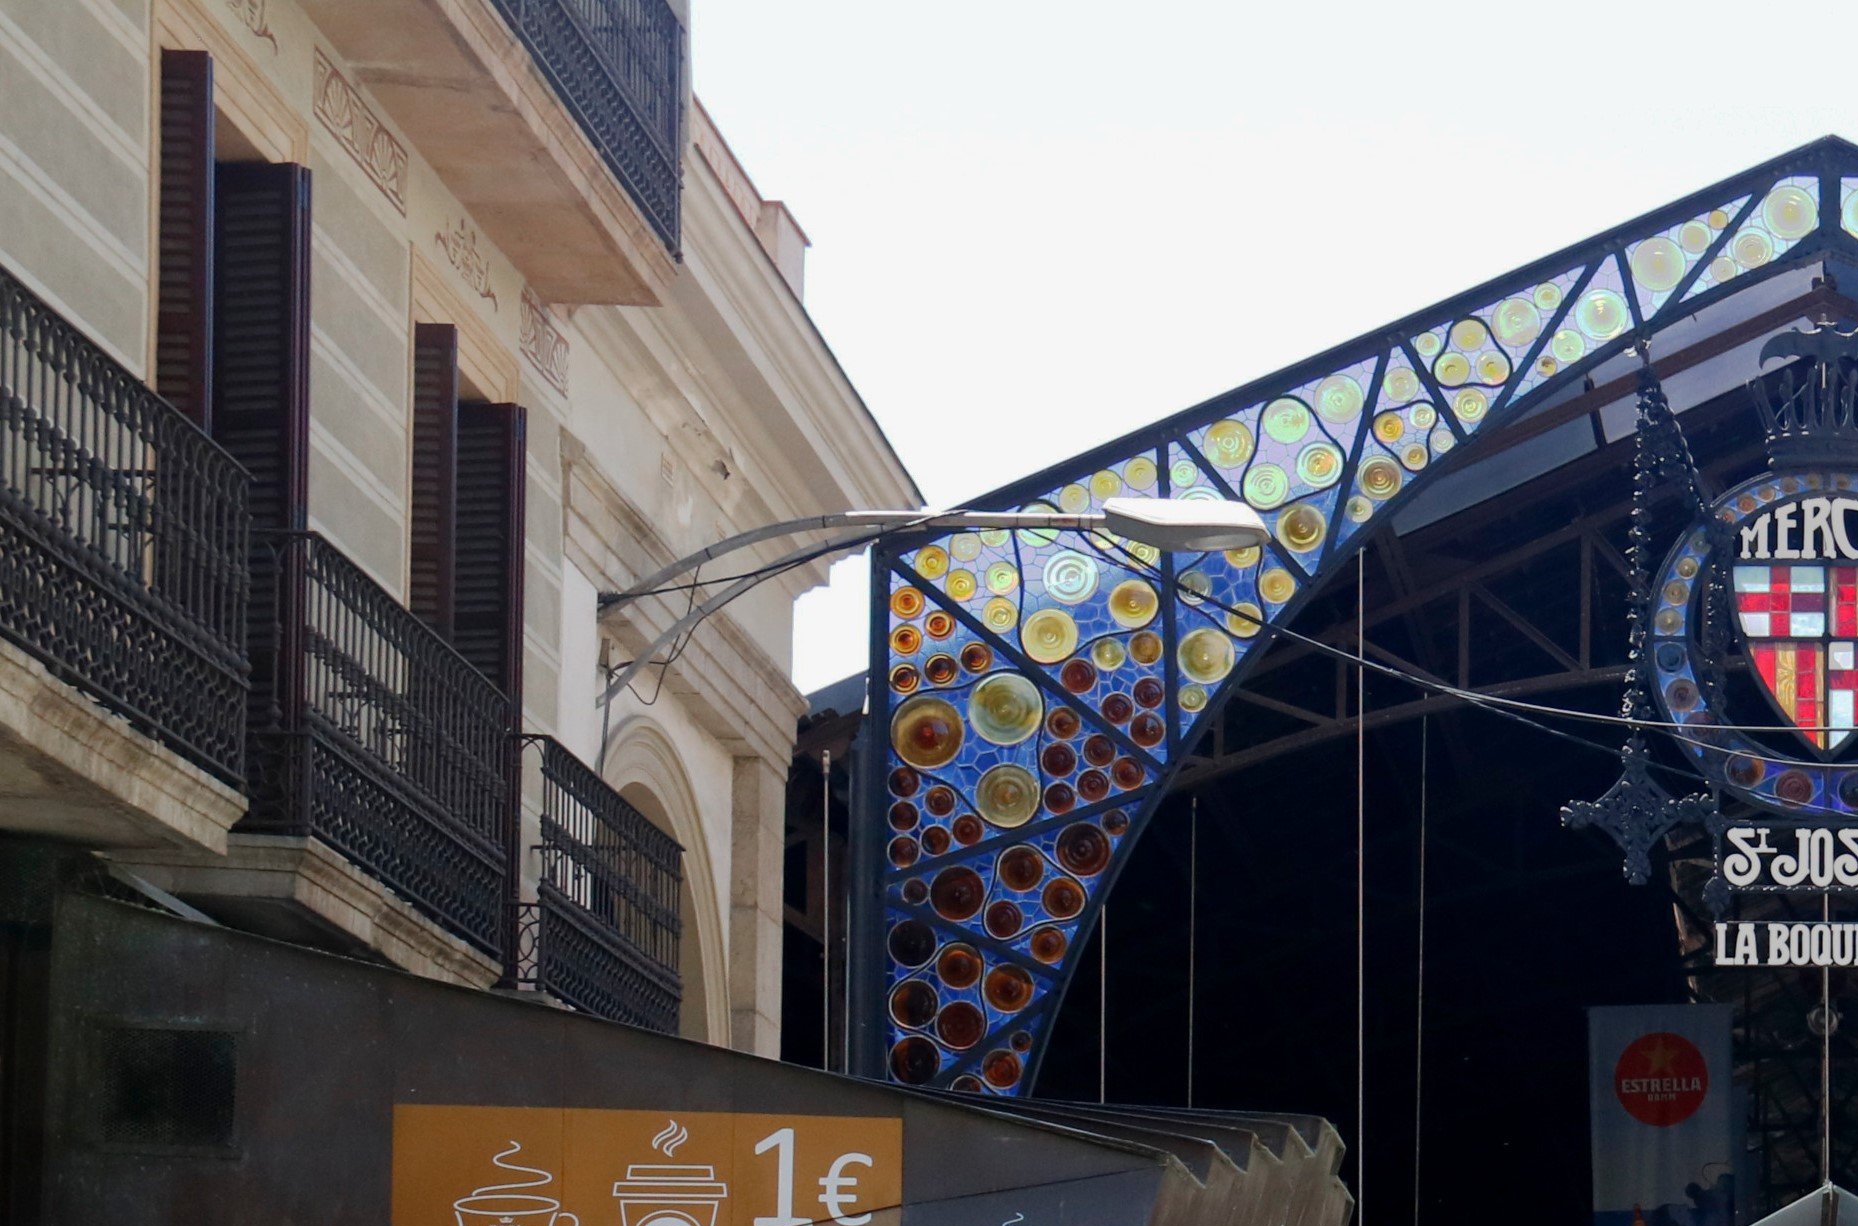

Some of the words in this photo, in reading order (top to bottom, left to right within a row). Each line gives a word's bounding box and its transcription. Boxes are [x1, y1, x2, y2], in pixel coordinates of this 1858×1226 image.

[1715, 922, 1759, 966] LA
[1621, 1077, 1702, 1093] ESTRELLA
[1647, 1092, 1677, 1102] DAMM
